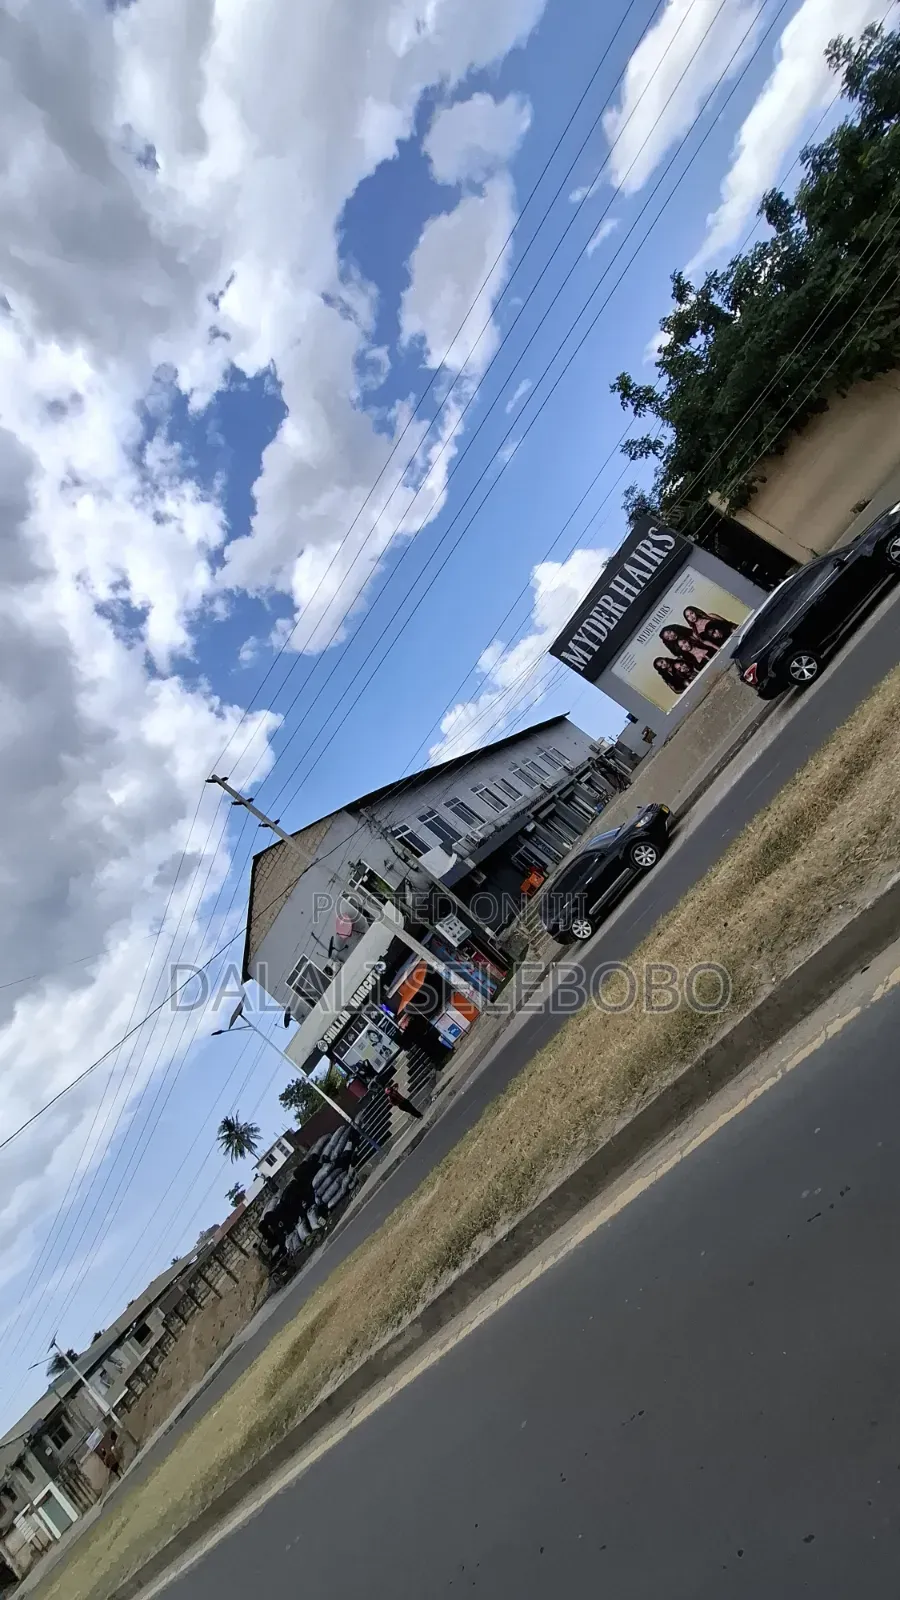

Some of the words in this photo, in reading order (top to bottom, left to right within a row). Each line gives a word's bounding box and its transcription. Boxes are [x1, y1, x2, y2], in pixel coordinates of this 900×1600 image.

[560, 594, 628, 671] MYDER
[608, 526, 675, 604] HAIRS
[636, 621, 657, 644] MYDER
[651, 603, 671, 625] HAIRS
